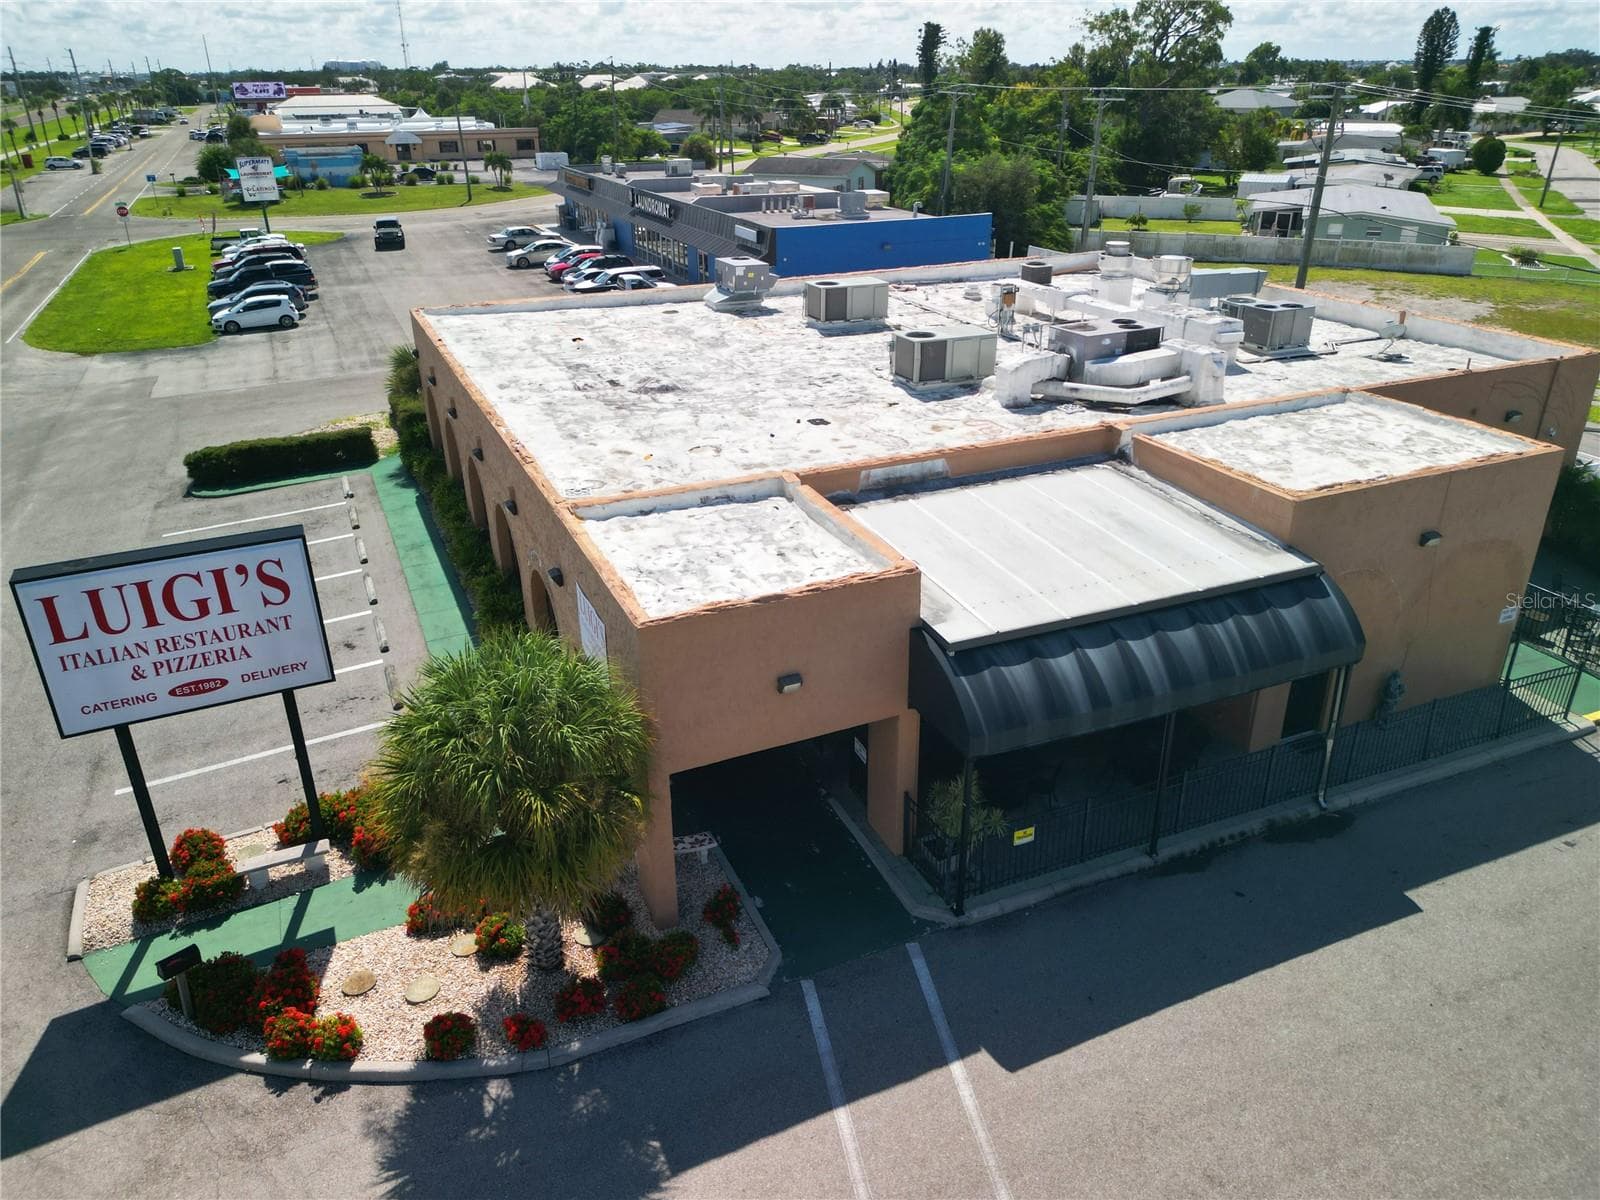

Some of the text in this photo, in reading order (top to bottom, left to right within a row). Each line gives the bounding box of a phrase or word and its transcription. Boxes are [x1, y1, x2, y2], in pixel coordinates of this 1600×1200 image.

[634, 193, 671, 218] LAUNDROMAT
[34, 558, 291, 646] LUIGI'S
[57, 614, 293, 672] ITALIAN RESTAURANT
[130, 645, 252, 682] & PIZZERIA
[80, 661, 309, 716] CATERING EST.1982 DELIVERY
